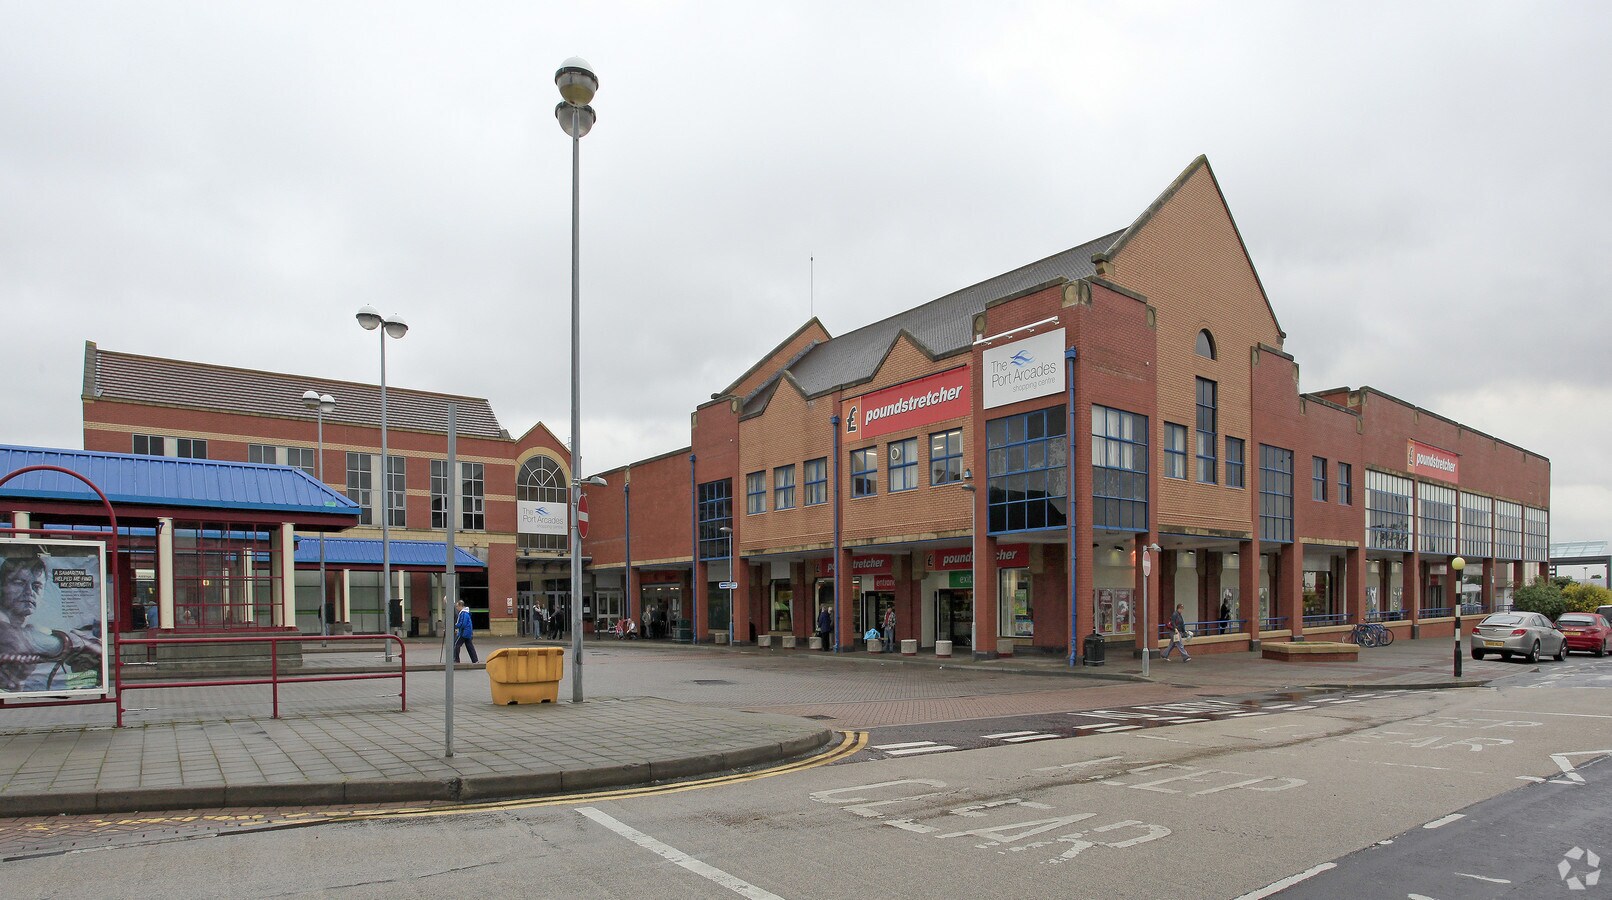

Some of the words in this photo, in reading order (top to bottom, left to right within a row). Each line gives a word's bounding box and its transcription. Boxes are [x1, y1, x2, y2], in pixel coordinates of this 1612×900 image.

[990, 360, 1008, 373] The
[991, 371, 1012, 388] Port
[1013, 362, 1057, 383] Arcades
[1012, 381, 1037, 393] shopping
[1037, 377, 1056, 387] centre
[846, 405, 858, 434] £
[865, 385, 964, 426] poundstretcher
[1416, 453, 1455, 472] poundstretcher
[523, 515, 536, 523] Port
[537, 515, 563, 524] Arcades
[876, 578, 896, 587] entranc
[959, 573, 972, 584] exit
